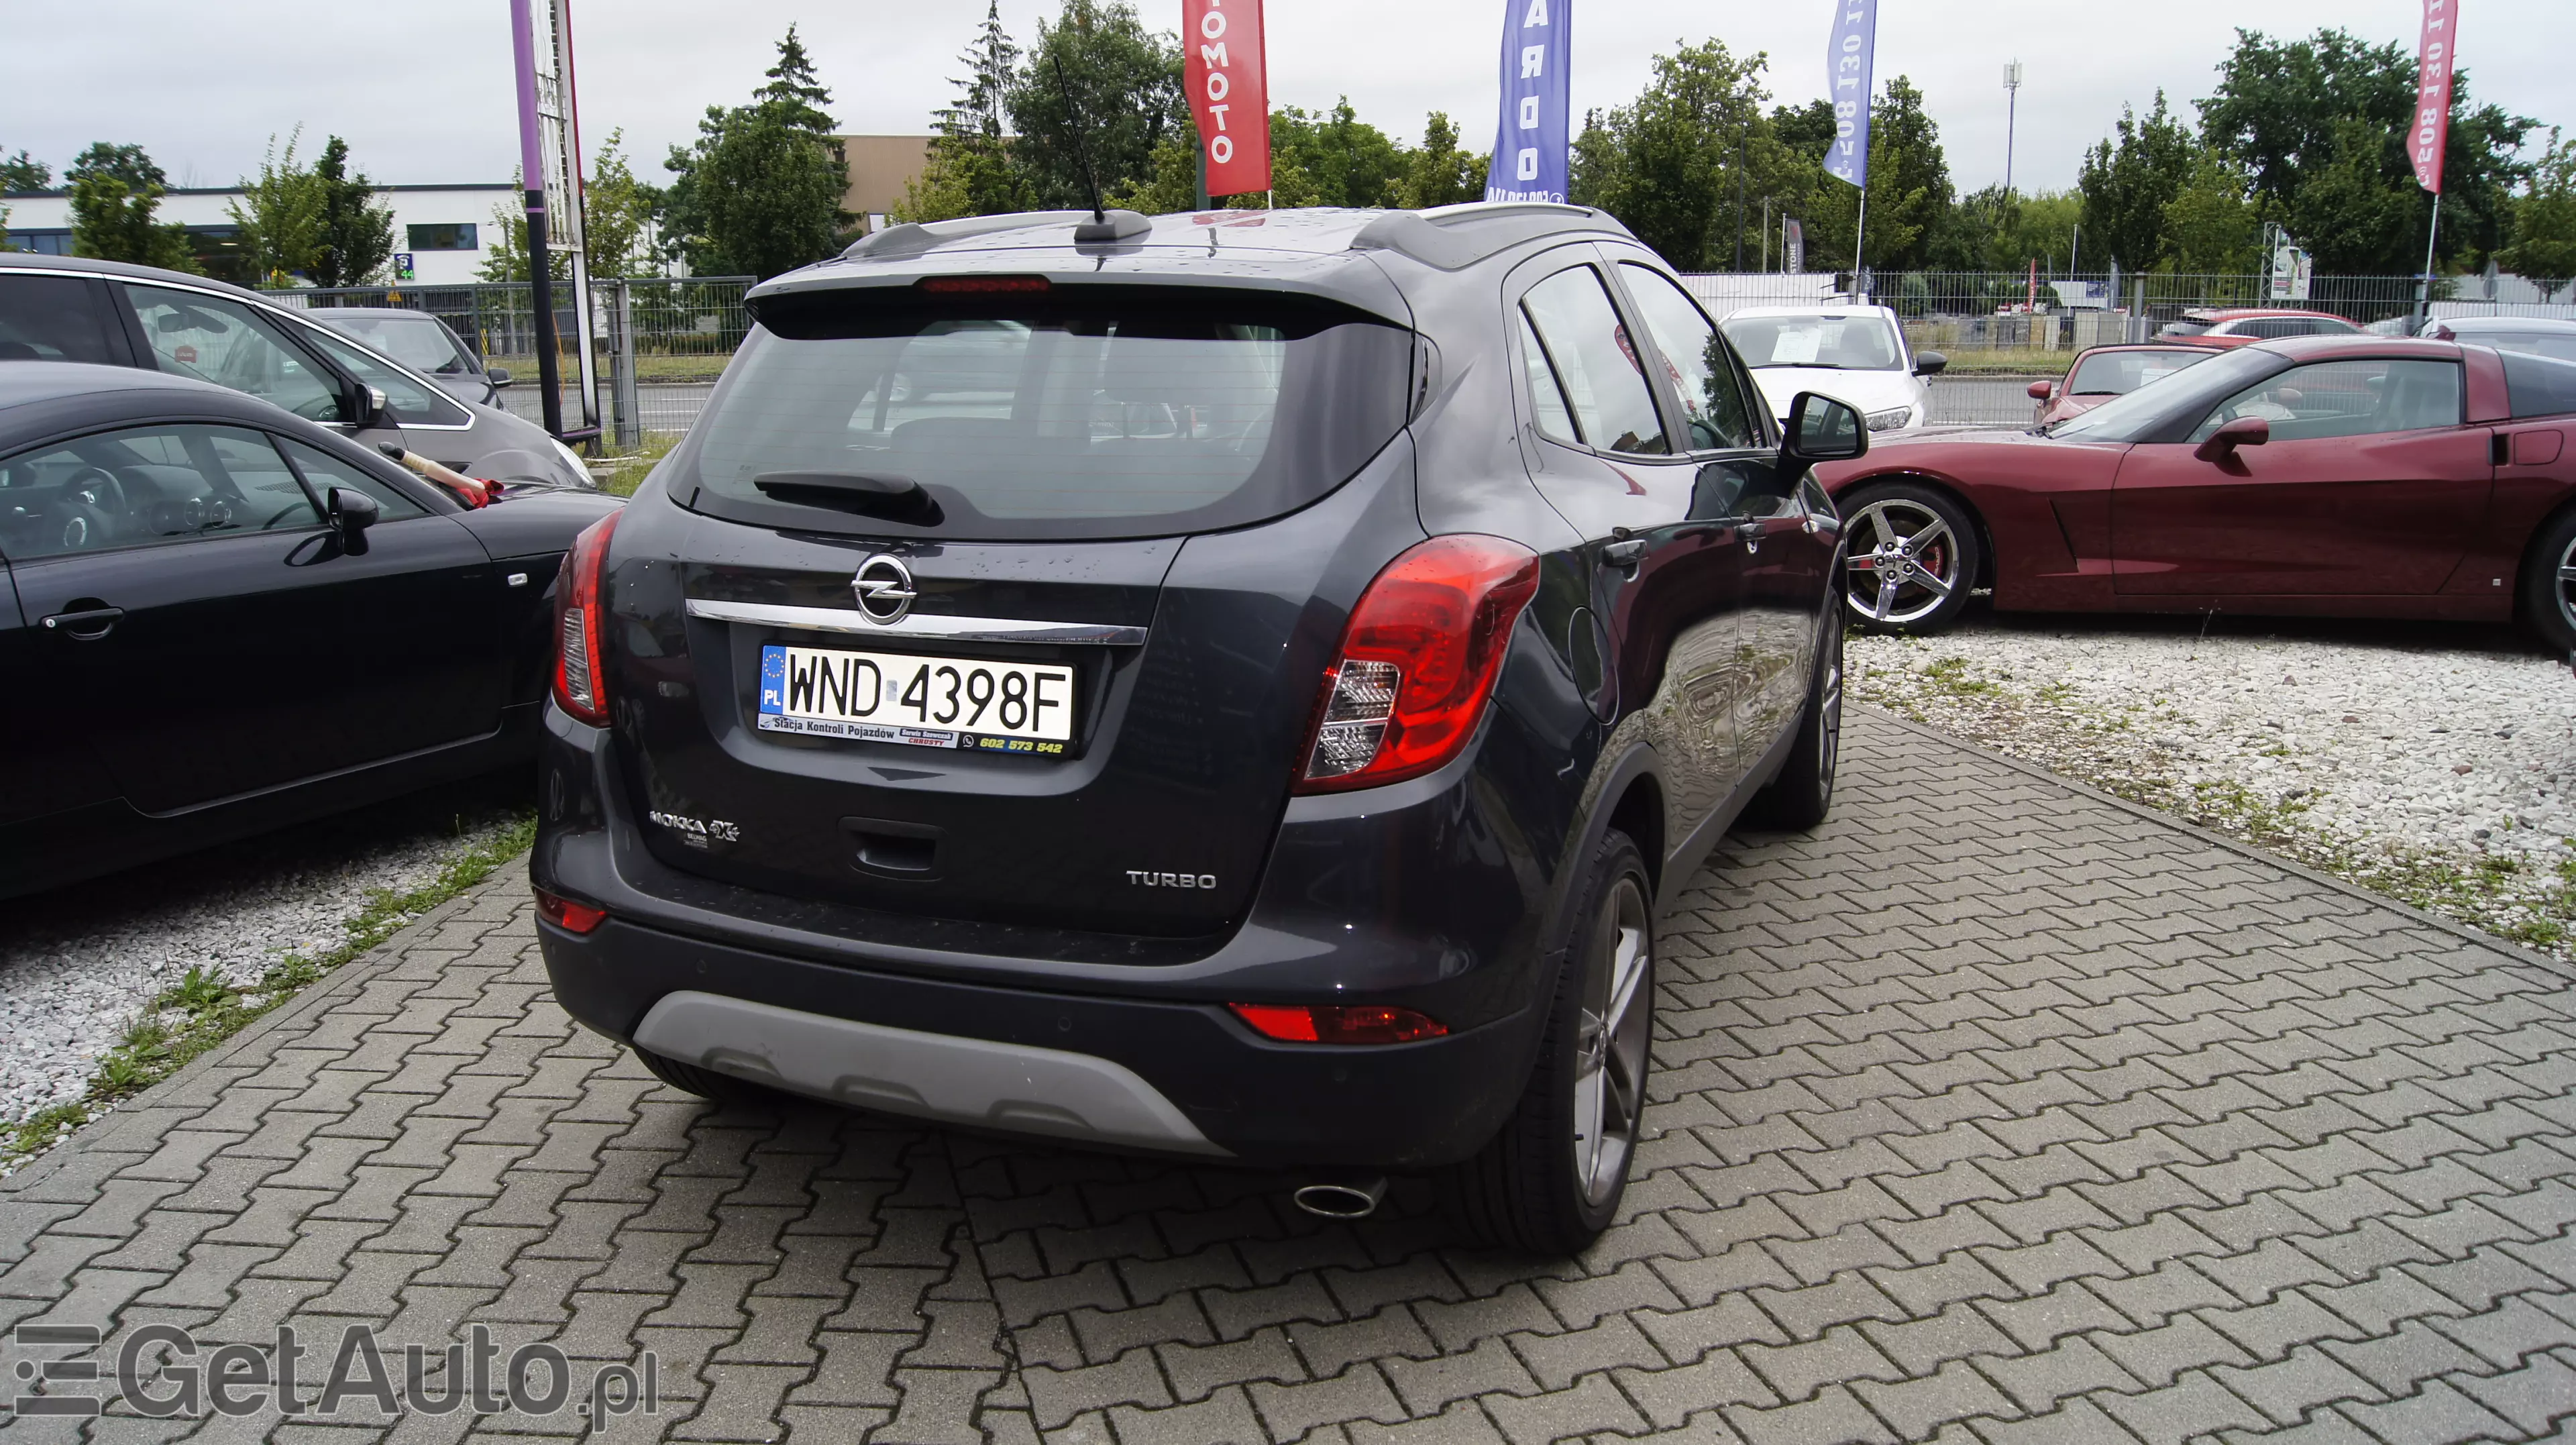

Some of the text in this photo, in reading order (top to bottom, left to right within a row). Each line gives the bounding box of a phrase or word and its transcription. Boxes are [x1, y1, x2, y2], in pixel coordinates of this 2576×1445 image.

[1201, 0, 1233, 164] OMOTO
[763, 688, 782, 707] PL
[790, 653, 1066, 732] WND 4398F
[774, 718, 895, 739] Stacja Kontroli Pojazdów
[908, 737, 945, 747] CHRUSTY
[979, 738, 1063, 753] 602 573 542
[649, 810, 707, 834] MOKKA
[1126, 870, 1217, 889] TURBO
